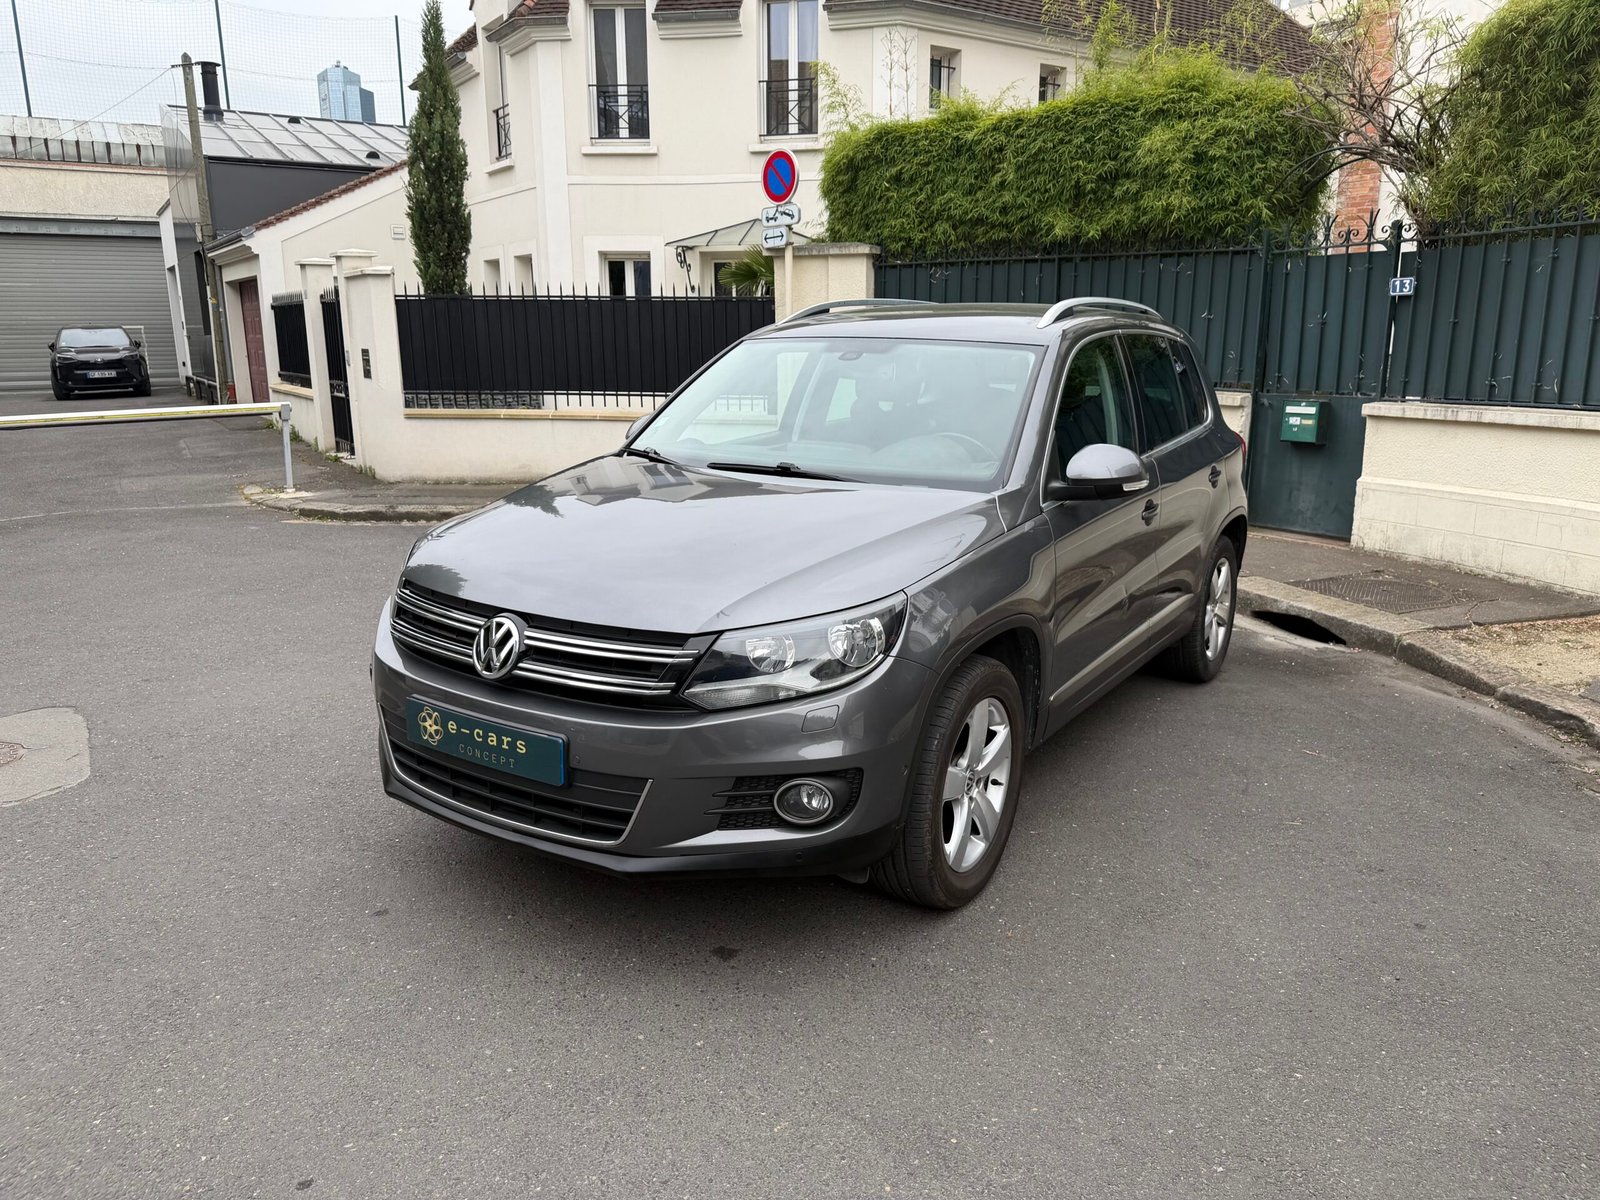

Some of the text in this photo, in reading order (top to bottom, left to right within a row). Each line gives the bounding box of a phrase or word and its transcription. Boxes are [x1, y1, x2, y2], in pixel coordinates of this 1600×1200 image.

[1395, 280, 1410, 293] 13
[477, 618, 517, 676] VW
[447, 720, 527, 754] e-cars
[458, 743, 516, 769] CONCEPT
